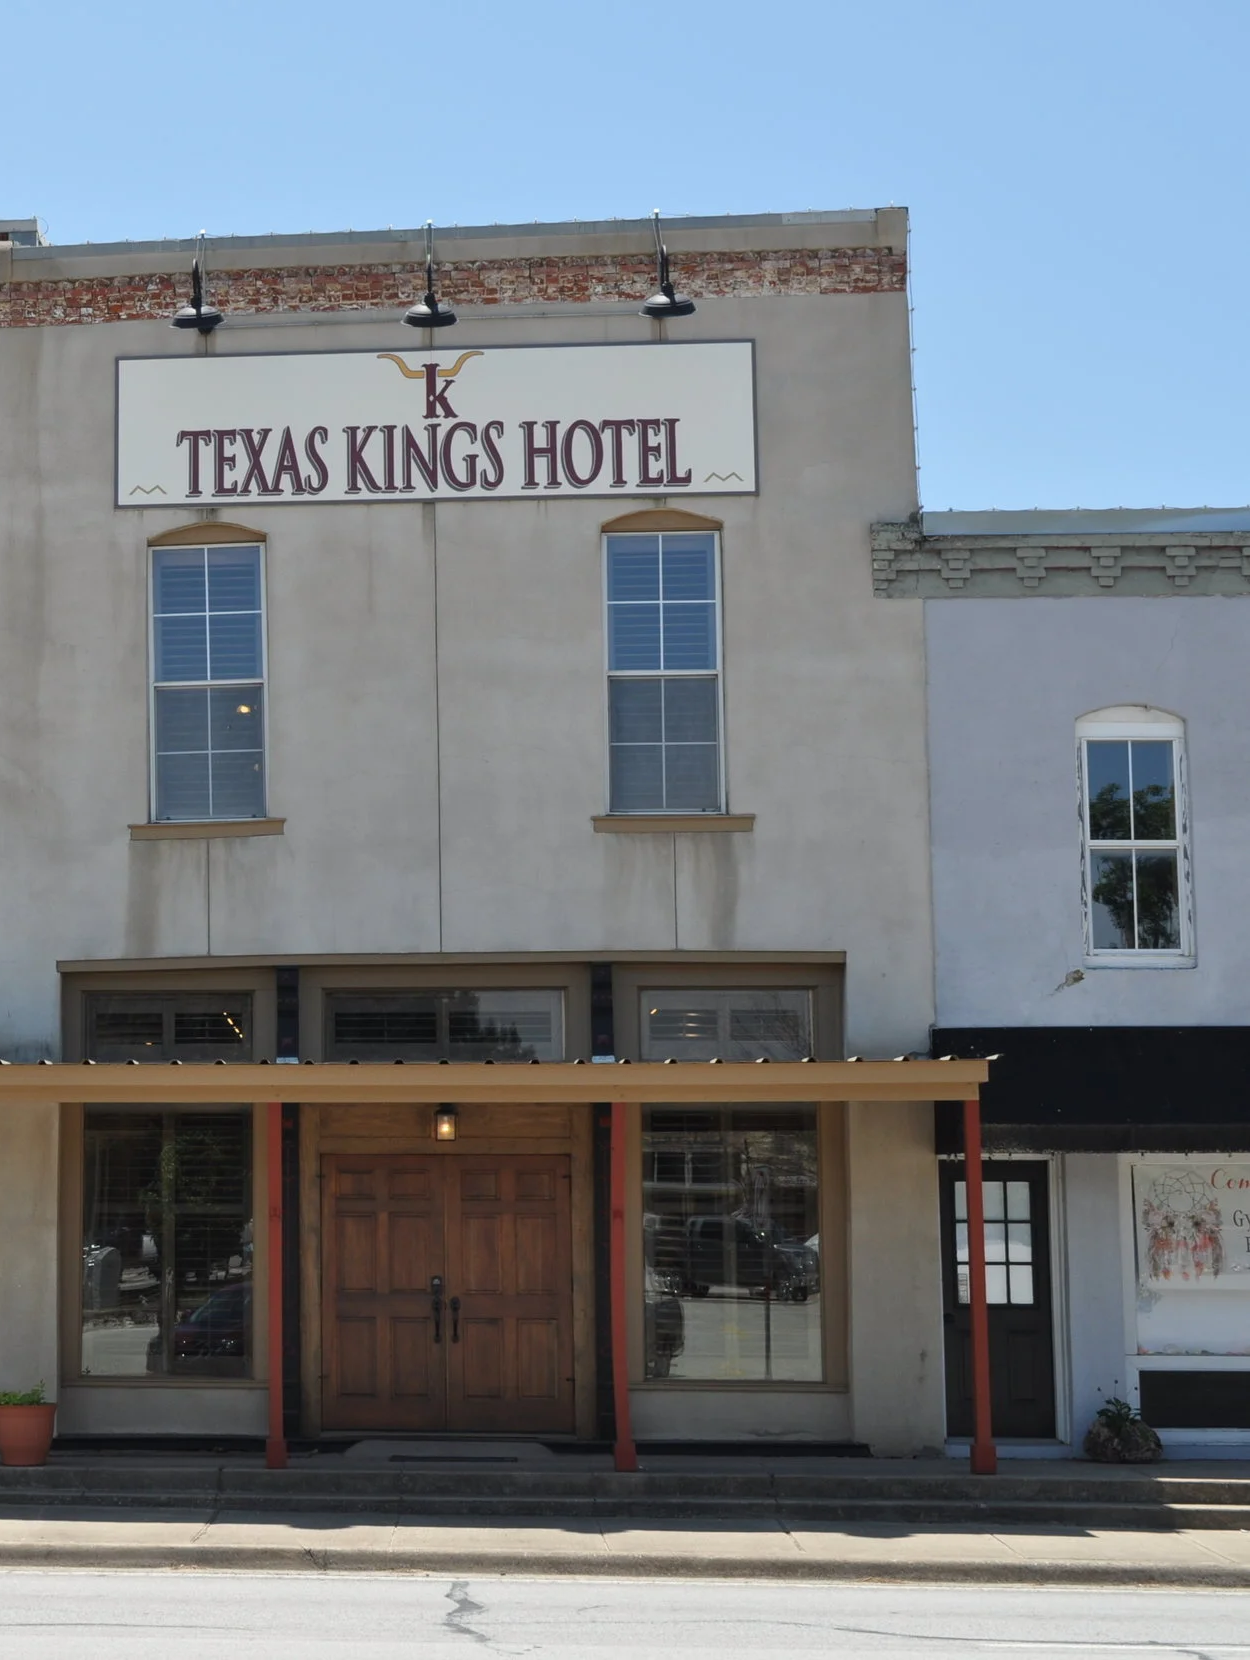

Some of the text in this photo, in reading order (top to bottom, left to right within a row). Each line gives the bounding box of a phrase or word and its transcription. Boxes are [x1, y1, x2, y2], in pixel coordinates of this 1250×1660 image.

[176, 418, 692, 498] TEXAS KINGS HOTEL
